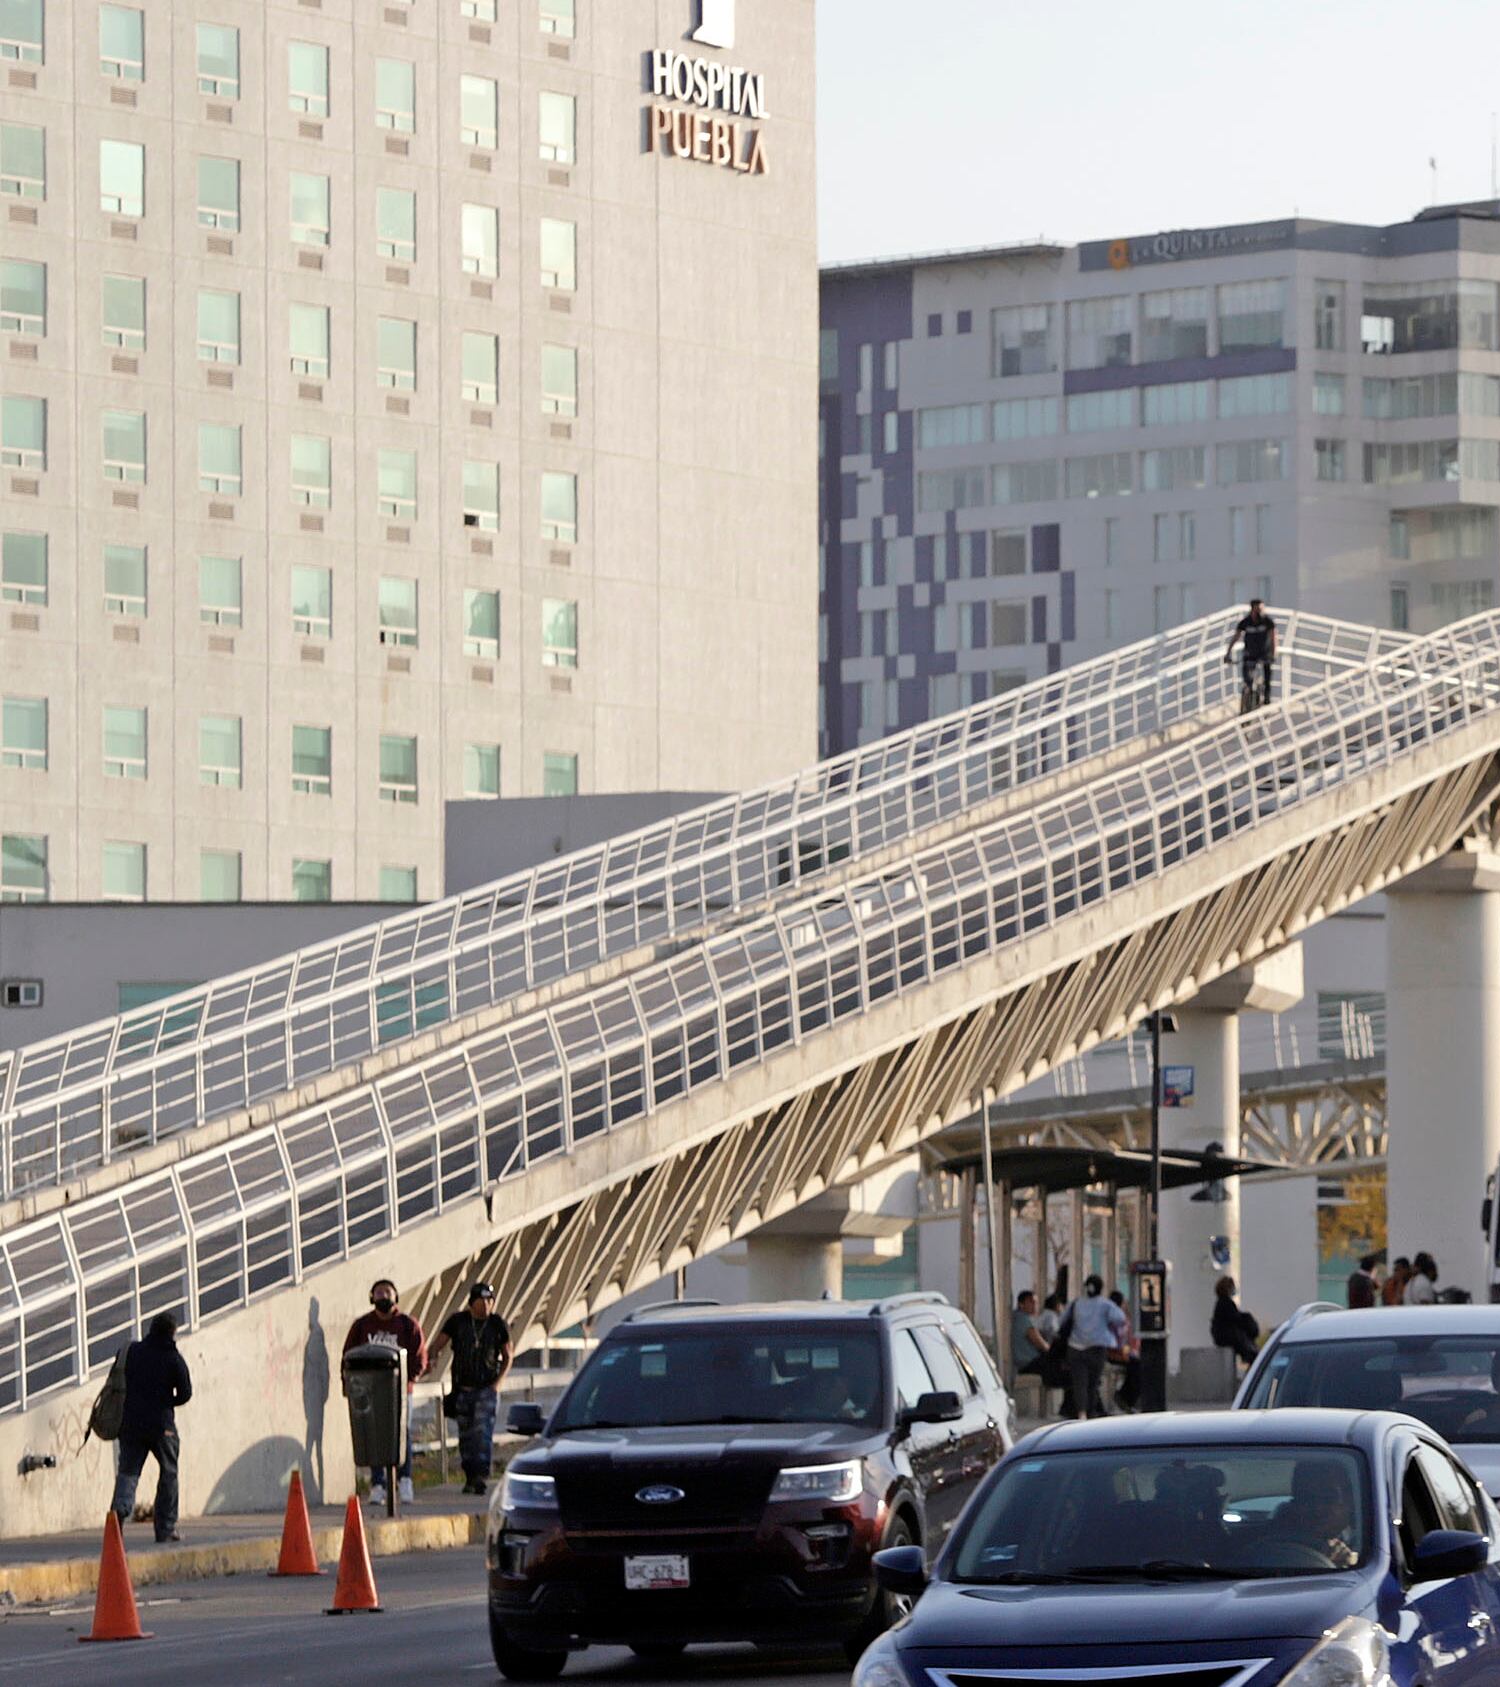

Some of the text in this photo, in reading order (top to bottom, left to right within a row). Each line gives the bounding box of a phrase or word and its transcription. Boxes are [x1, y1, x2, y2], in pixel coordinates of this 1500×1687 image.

[651, 48, 771, 121] HOSPITAL
[651, 104, 771, 175] PUEBLA
[1153, 230, 1228, 261] QUINTA
